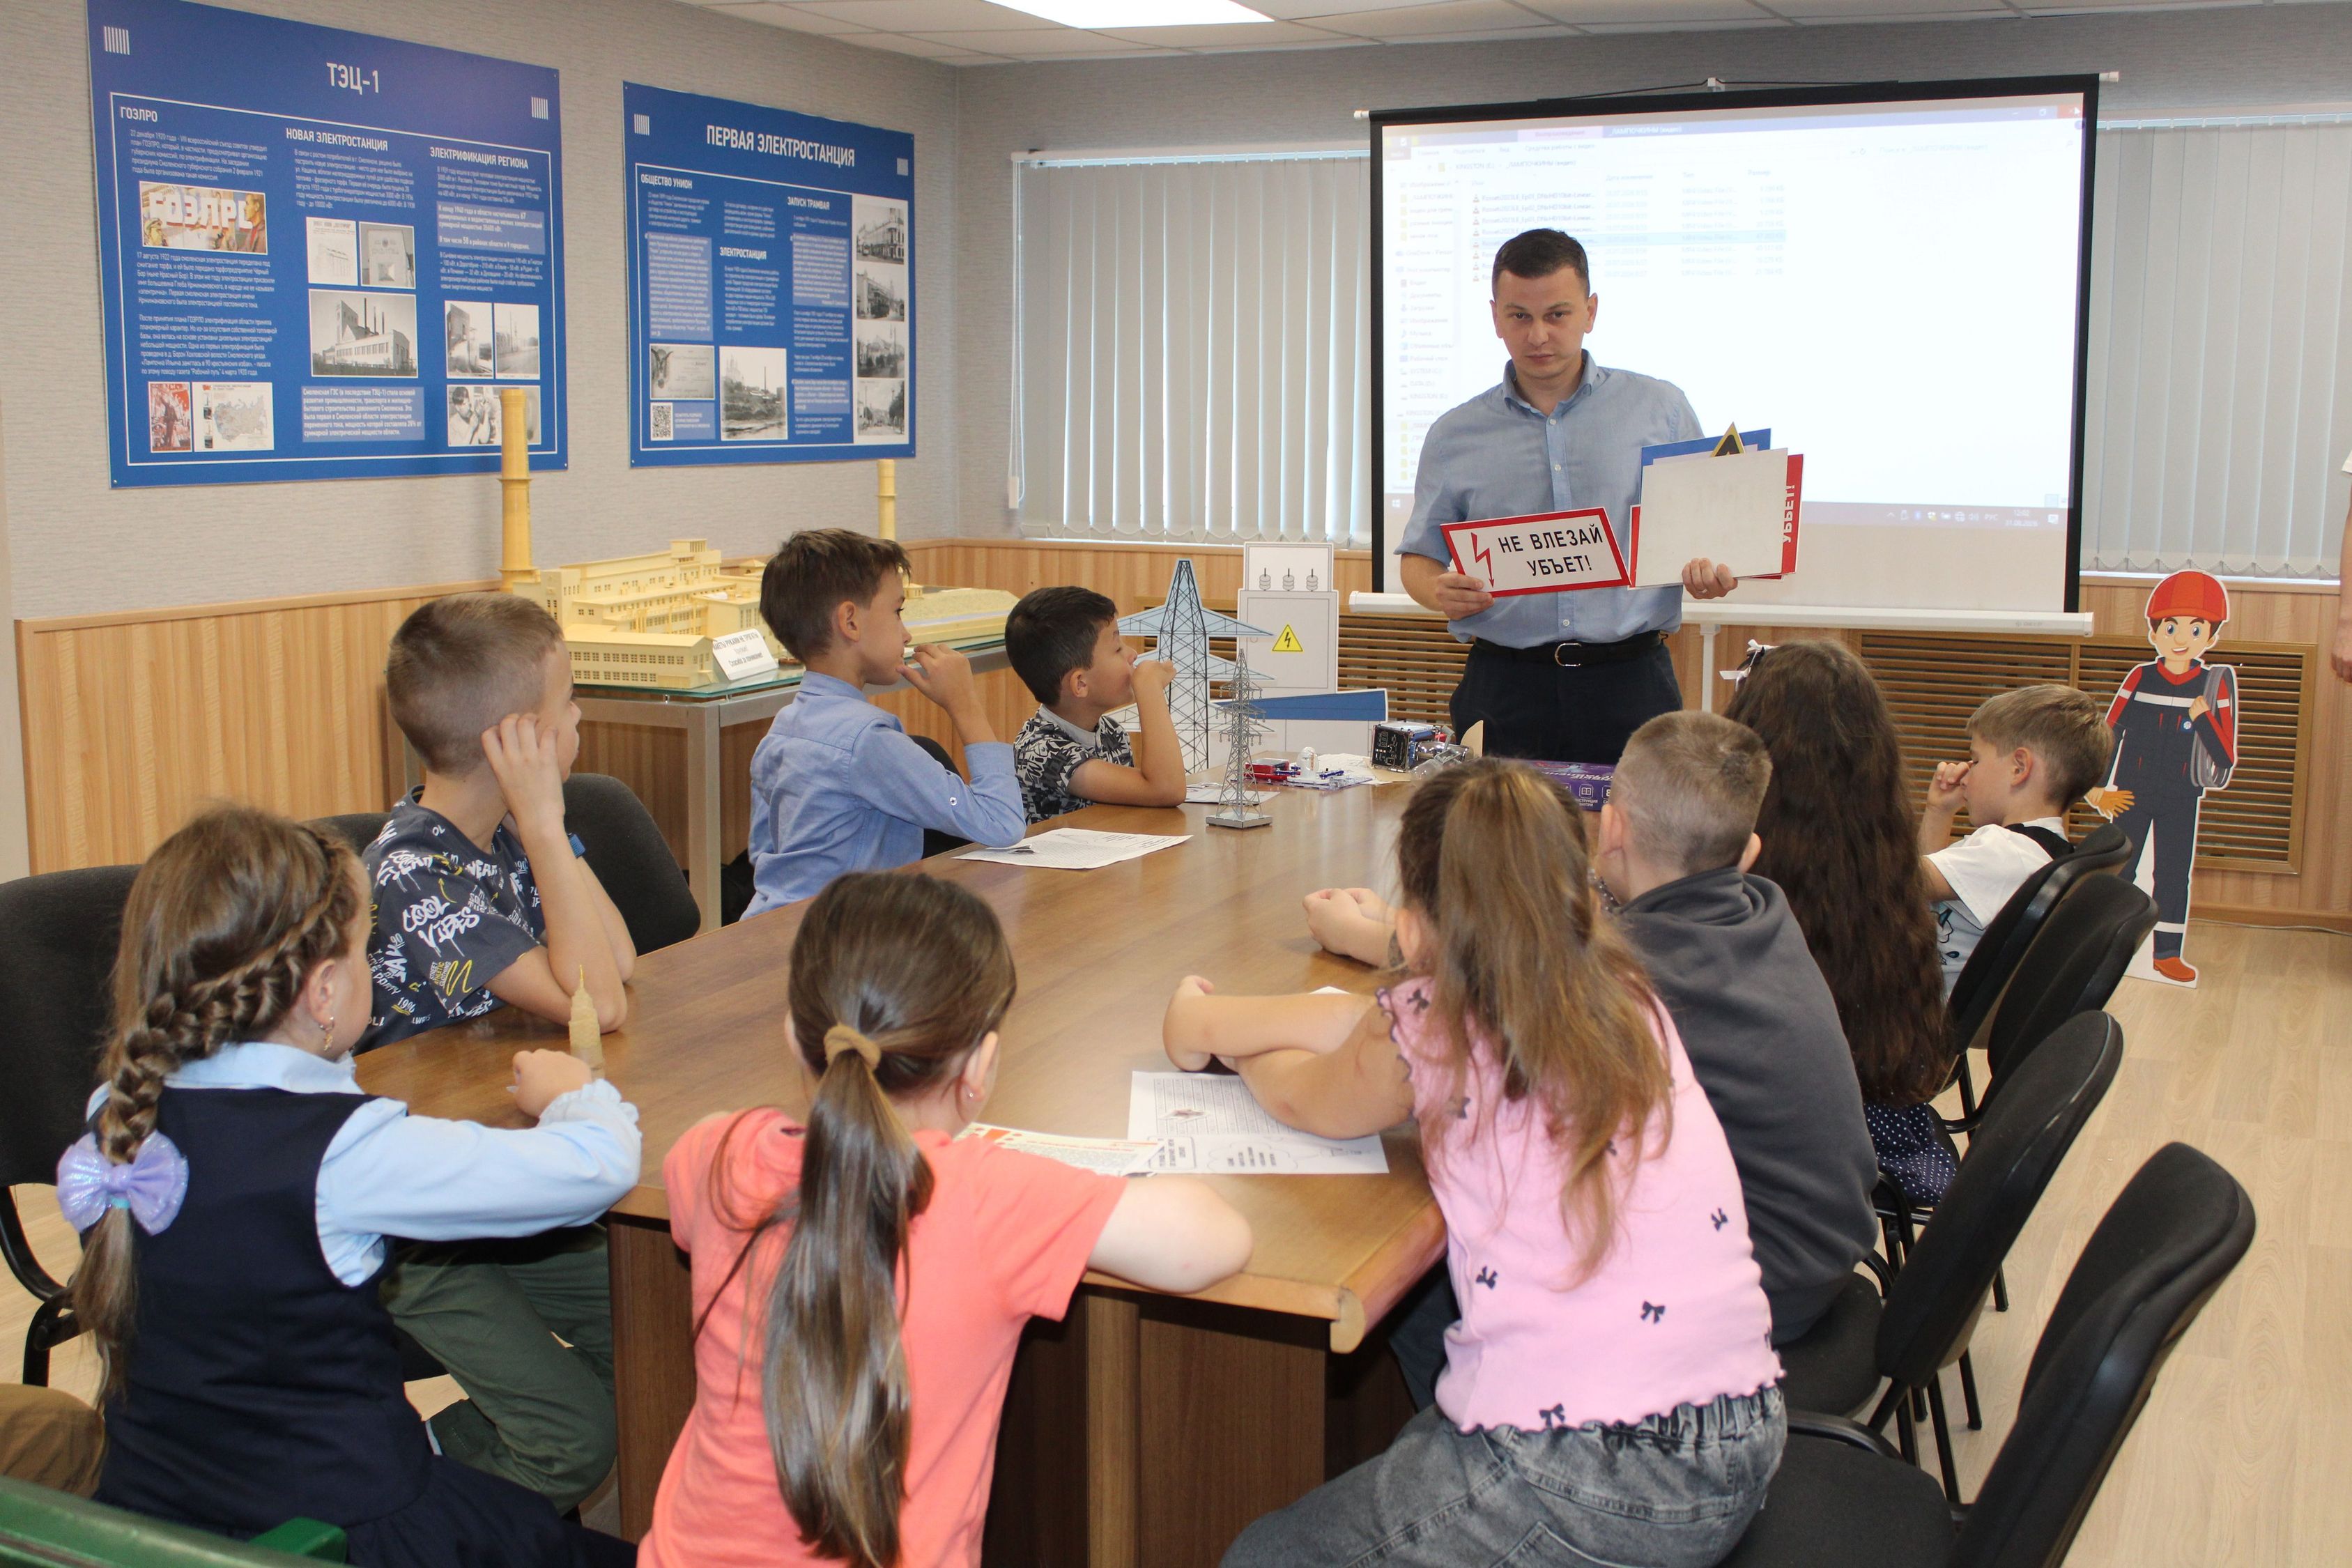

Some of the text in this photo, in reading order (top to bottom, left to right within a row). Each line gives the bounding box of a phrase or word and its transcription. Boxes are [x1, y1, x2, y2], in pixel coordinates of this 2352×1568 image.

[327, 62, 379, 93] ТЭЦ-1
[120, 106, 157, 123] ГОЭЛРО
[286, 128, 387, 151] НОВАЯ ЭЛЕКТРОСТАНЦИЯ
[707, 125, 855, 168] ПЕРВАЯ ЭЛЕКТРОСТАНЦИЯ
[430, 146, 528, 169] ЭЛЕКТРИФИКАЦИЯ РЕГИОНА
[640, 174, 693, 190] ОБЩЕСТВО УНИОН
[787, 196, 830, 211] ЗАПУСК ТРАМВАЯ
[720, 247, 767, 261] ЭЛЕКТРОСТАНЦИЯ
[1498, 523, 1604, 554] НЕ ВЛЕЗАЙ
[1526, 554, 1592, 577] УБЪЕТ!
[403, 894, 451, 933] COOL
[418, 905, 480, 948] VIBES
[429, 961, 438, 980] STREET
[434, 962, 445, 985] ATHLETIC
[439, 961, 452, 987] CLOTHING
